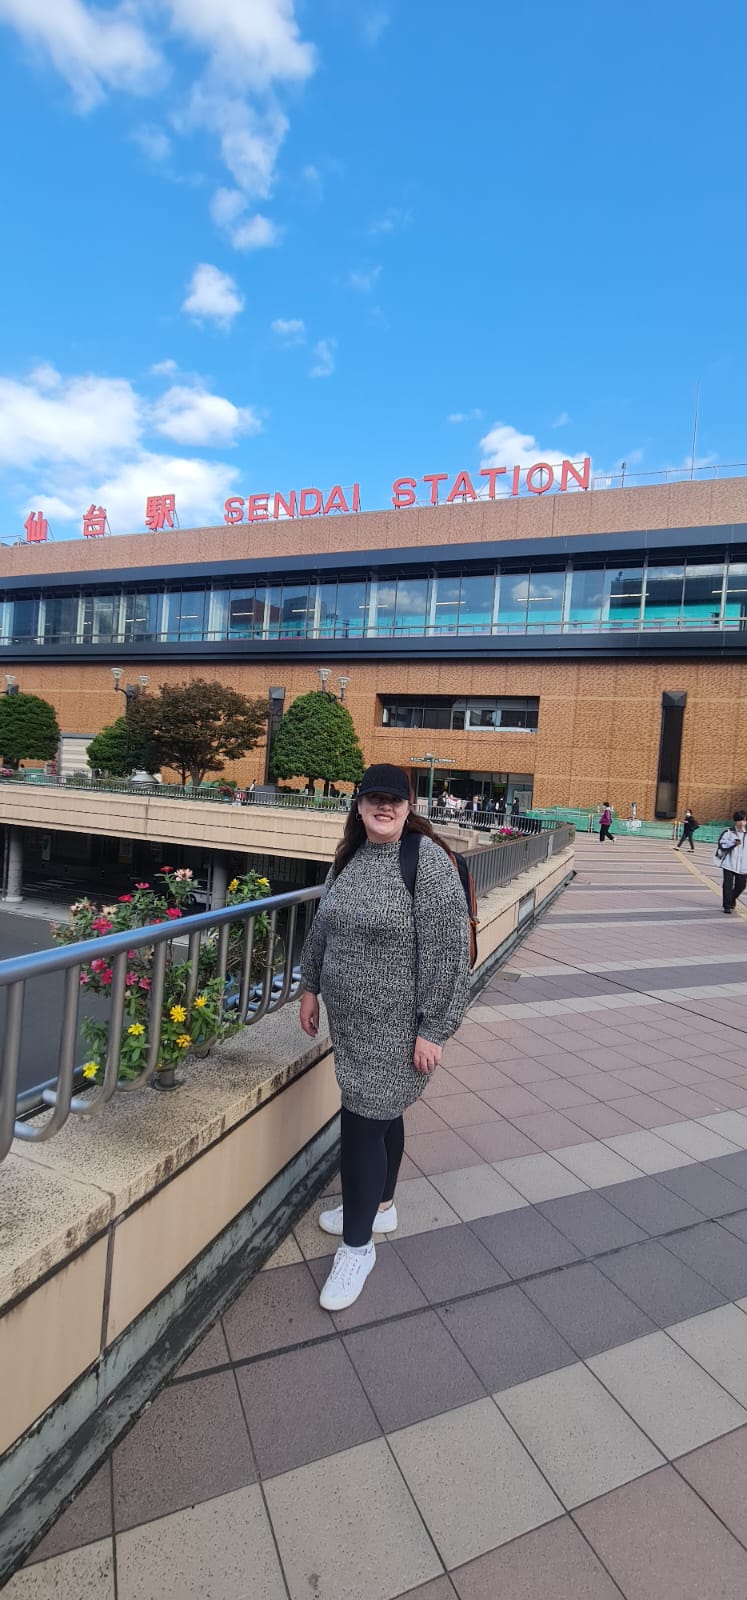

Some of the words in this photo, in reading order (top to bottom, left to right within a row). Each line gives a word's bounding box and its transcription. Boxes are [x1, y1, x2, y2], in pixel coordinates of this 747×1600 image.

[24, 494, 176, 543] 仙台駅
[223, 483, 361, 524] SENDAI
[392, 457, 591, 507] STATION
